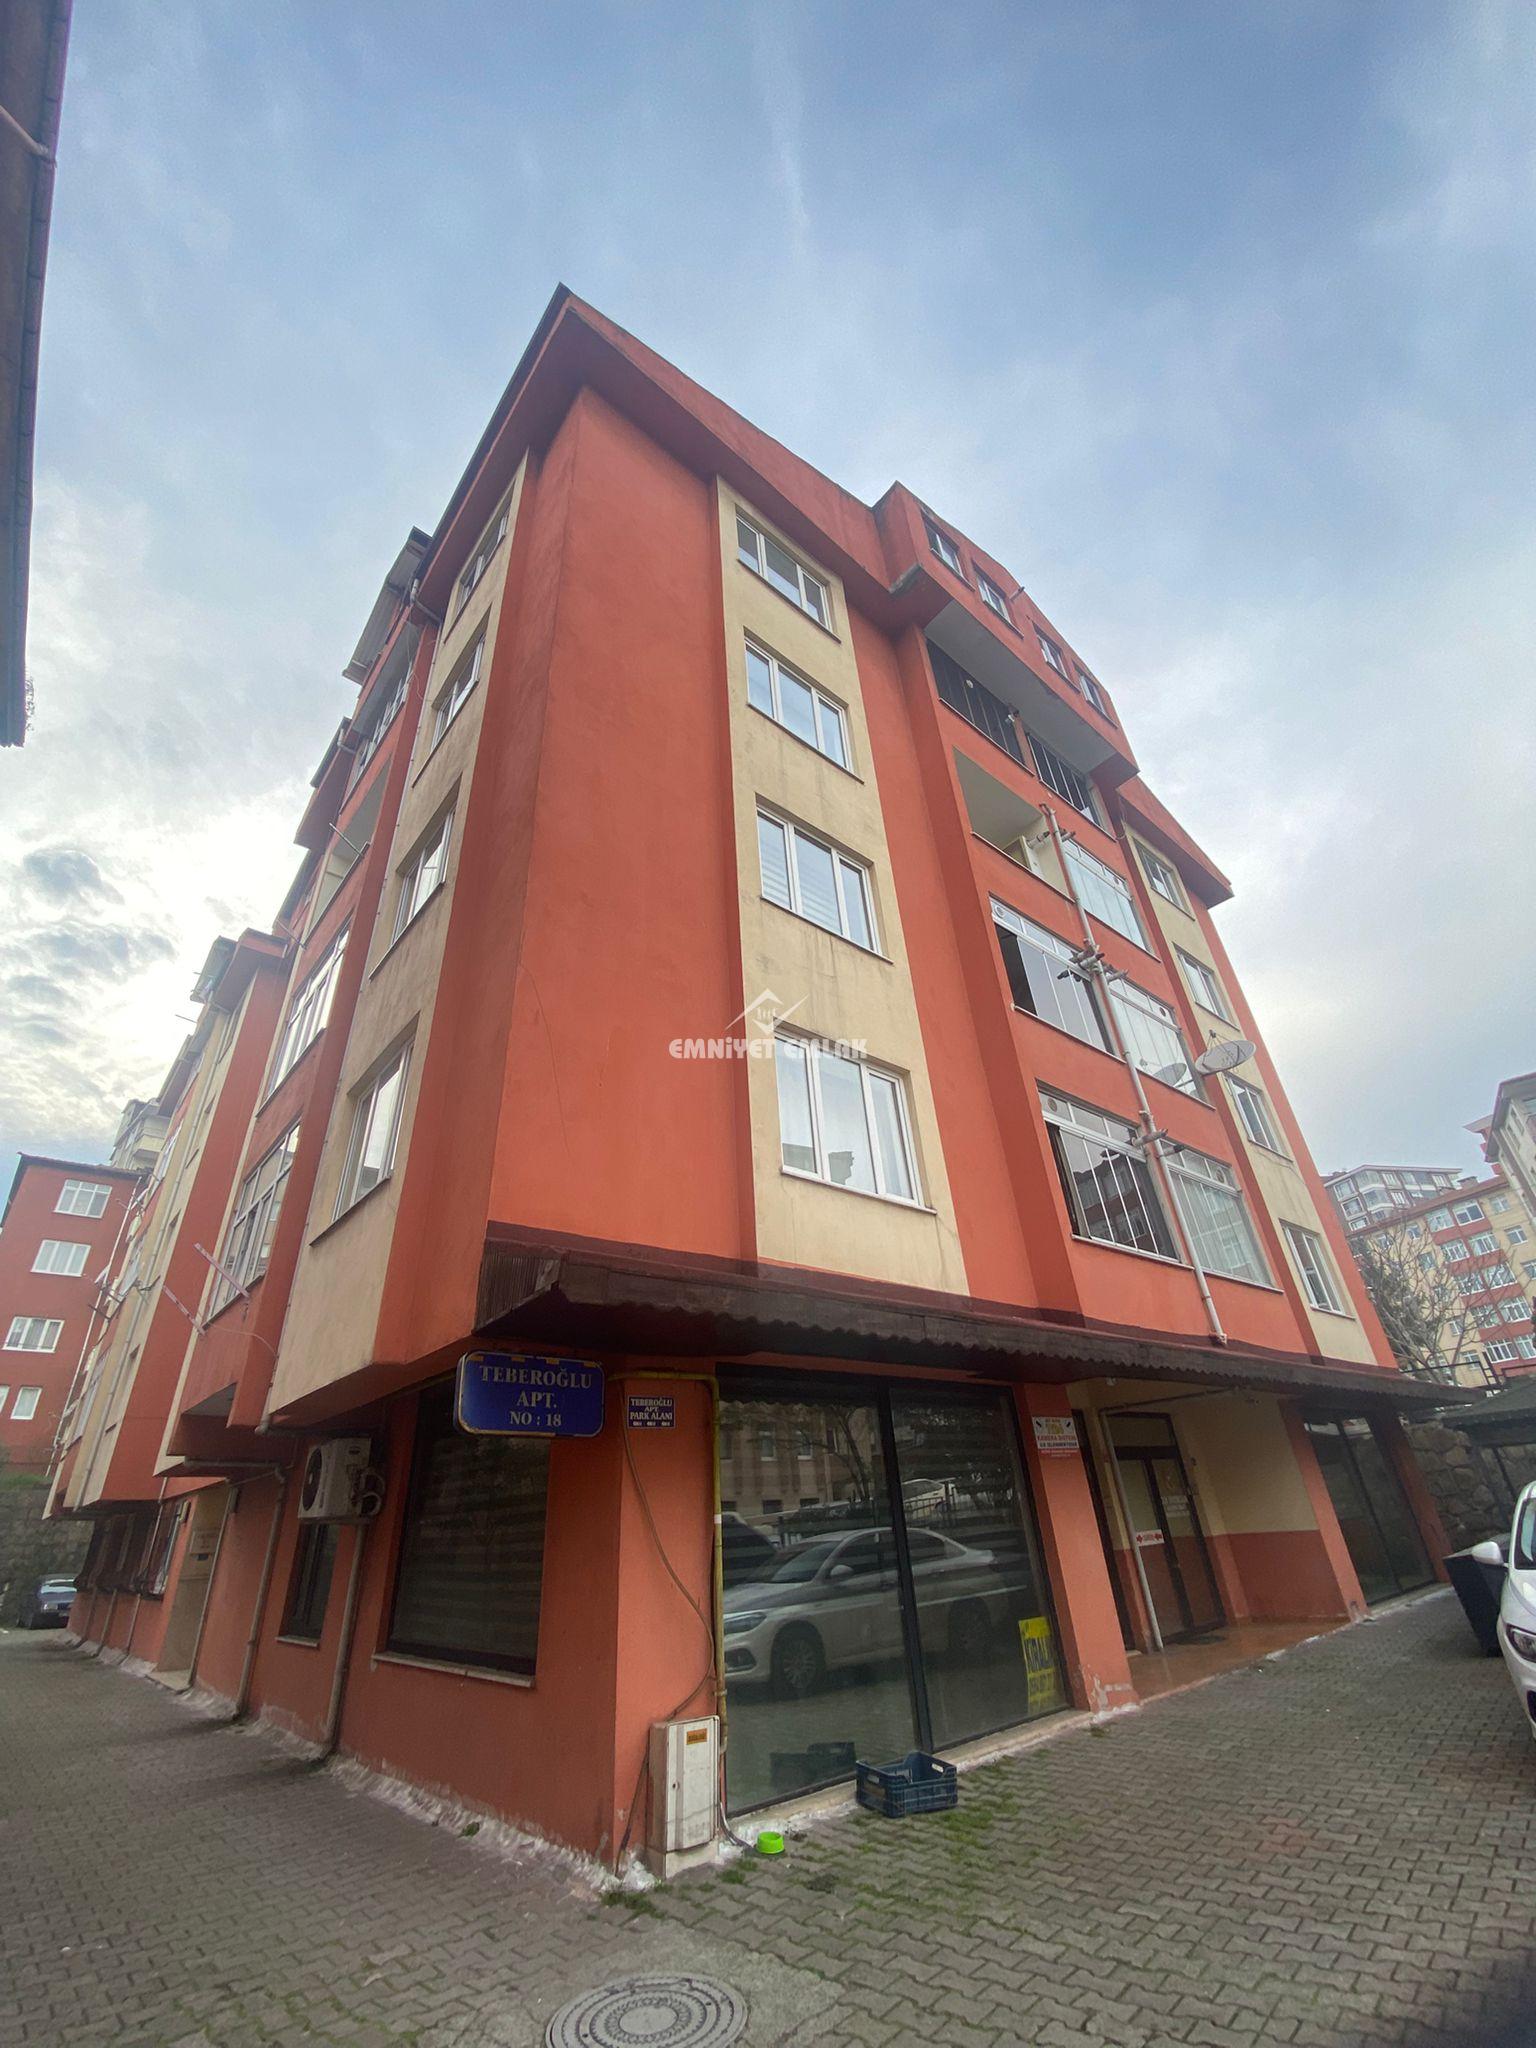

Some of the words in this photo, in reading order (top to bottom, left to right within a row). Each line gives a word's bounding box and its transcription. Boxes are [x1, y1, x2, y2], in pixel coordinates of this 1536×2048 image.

[479, 1365, 592, 1389] TEBEROĞLU
[516, 1389, 557, 1409] APT.
[630, 1397, 672, 1406] TEBEROĞLU
[509, 1411, 532, 1425] NO
[546, 1413, 562, 1427] 18
[630, 1411, 649, 1420] PARK
[651, 1412, 673, 1420] ALANI
